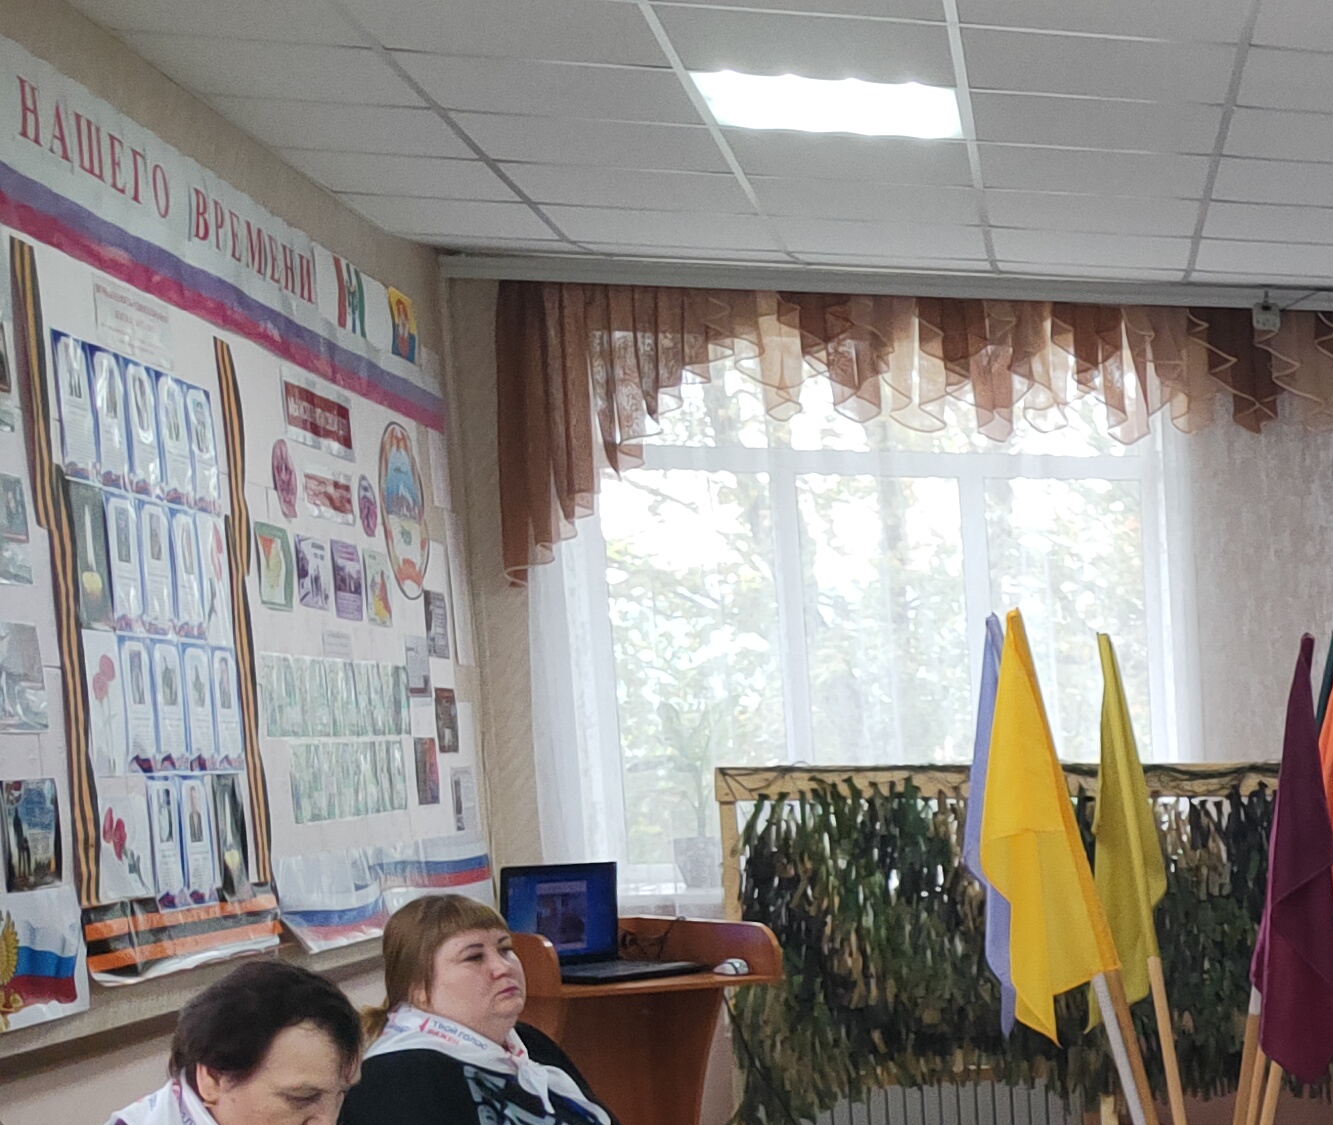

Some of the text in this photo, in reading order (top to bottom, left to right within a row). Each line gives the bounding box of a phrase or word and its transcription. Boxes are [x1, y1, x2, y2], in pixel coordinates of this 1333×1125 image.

[17, 75, 316, 305] НАШЕГО ВРЕМЕНИ
[432, 1020, 489, 1050] ТВОЙ ГОЛОС
